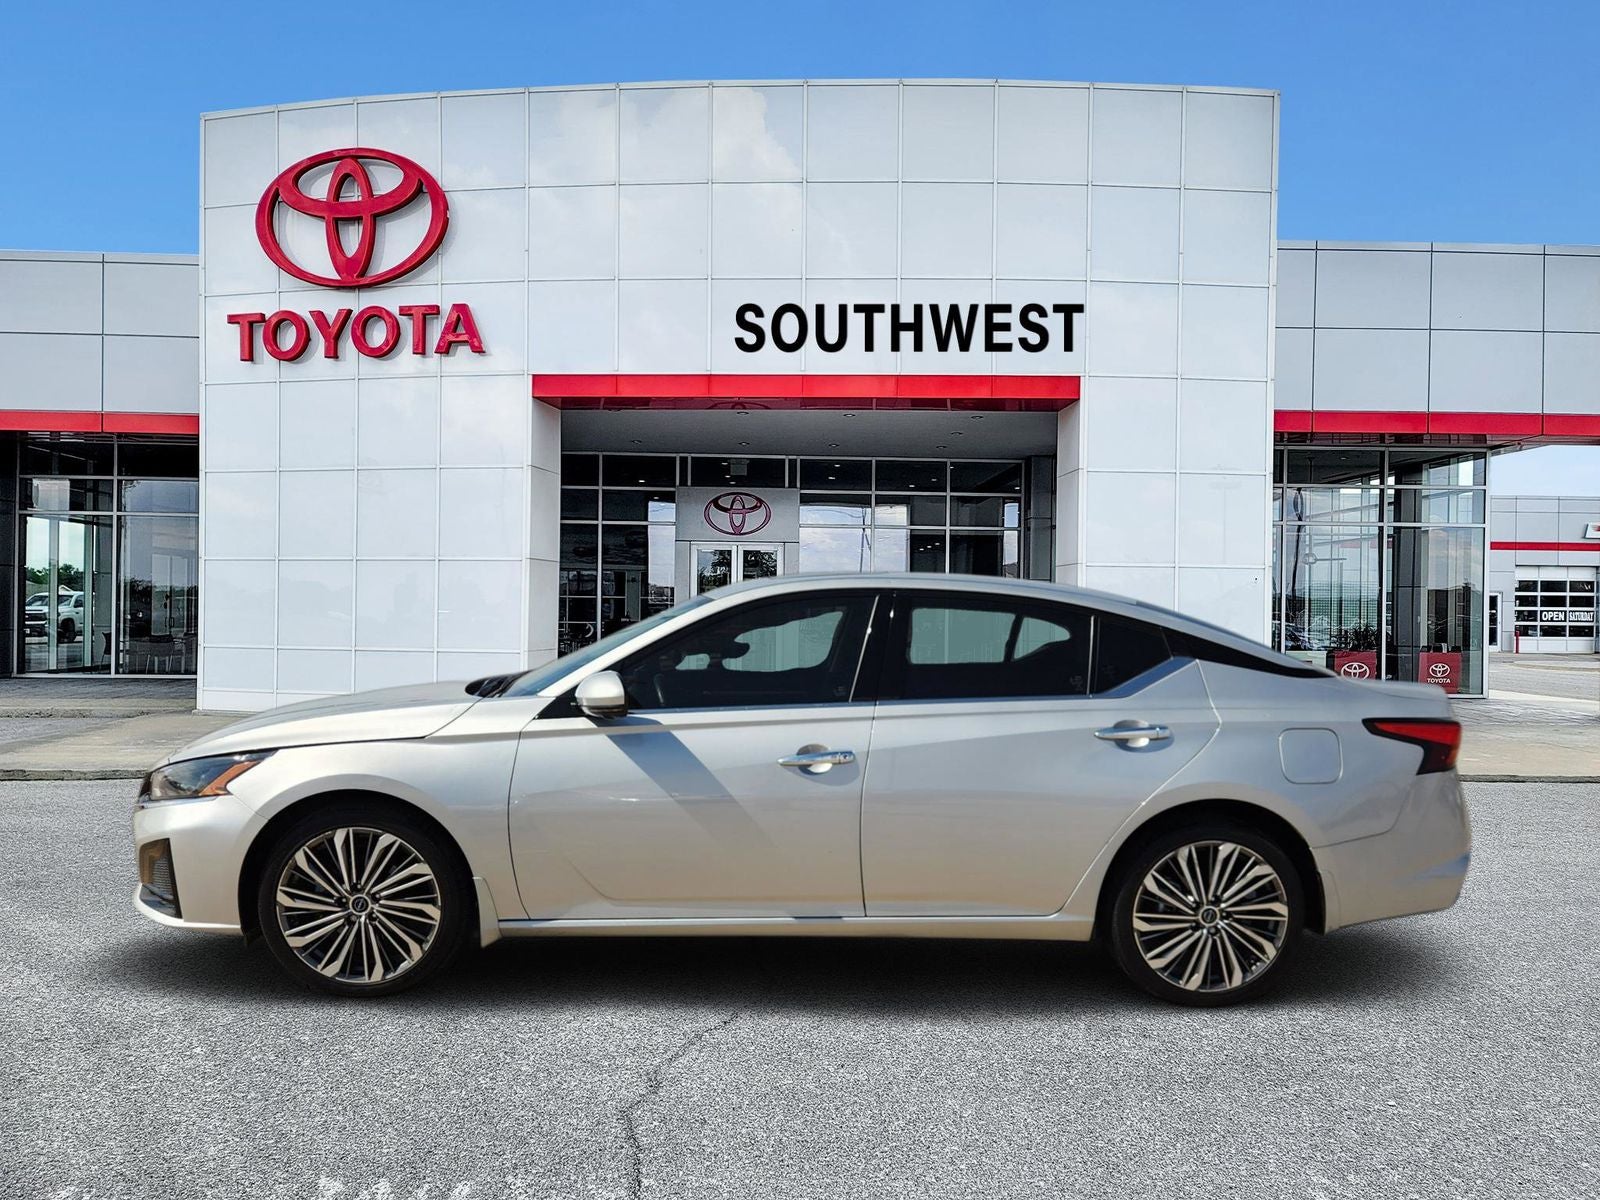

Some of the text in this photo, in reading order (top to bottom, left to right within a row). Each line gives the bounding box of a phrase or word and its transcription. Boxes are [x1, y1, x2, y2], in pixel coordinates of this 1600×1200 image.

[227, 303, 486, 362] TOYOTA
[734, 303, 1085, 353] SOUTHWEST
[1541, 611, 1594, 621] OPEN SATURDAY
